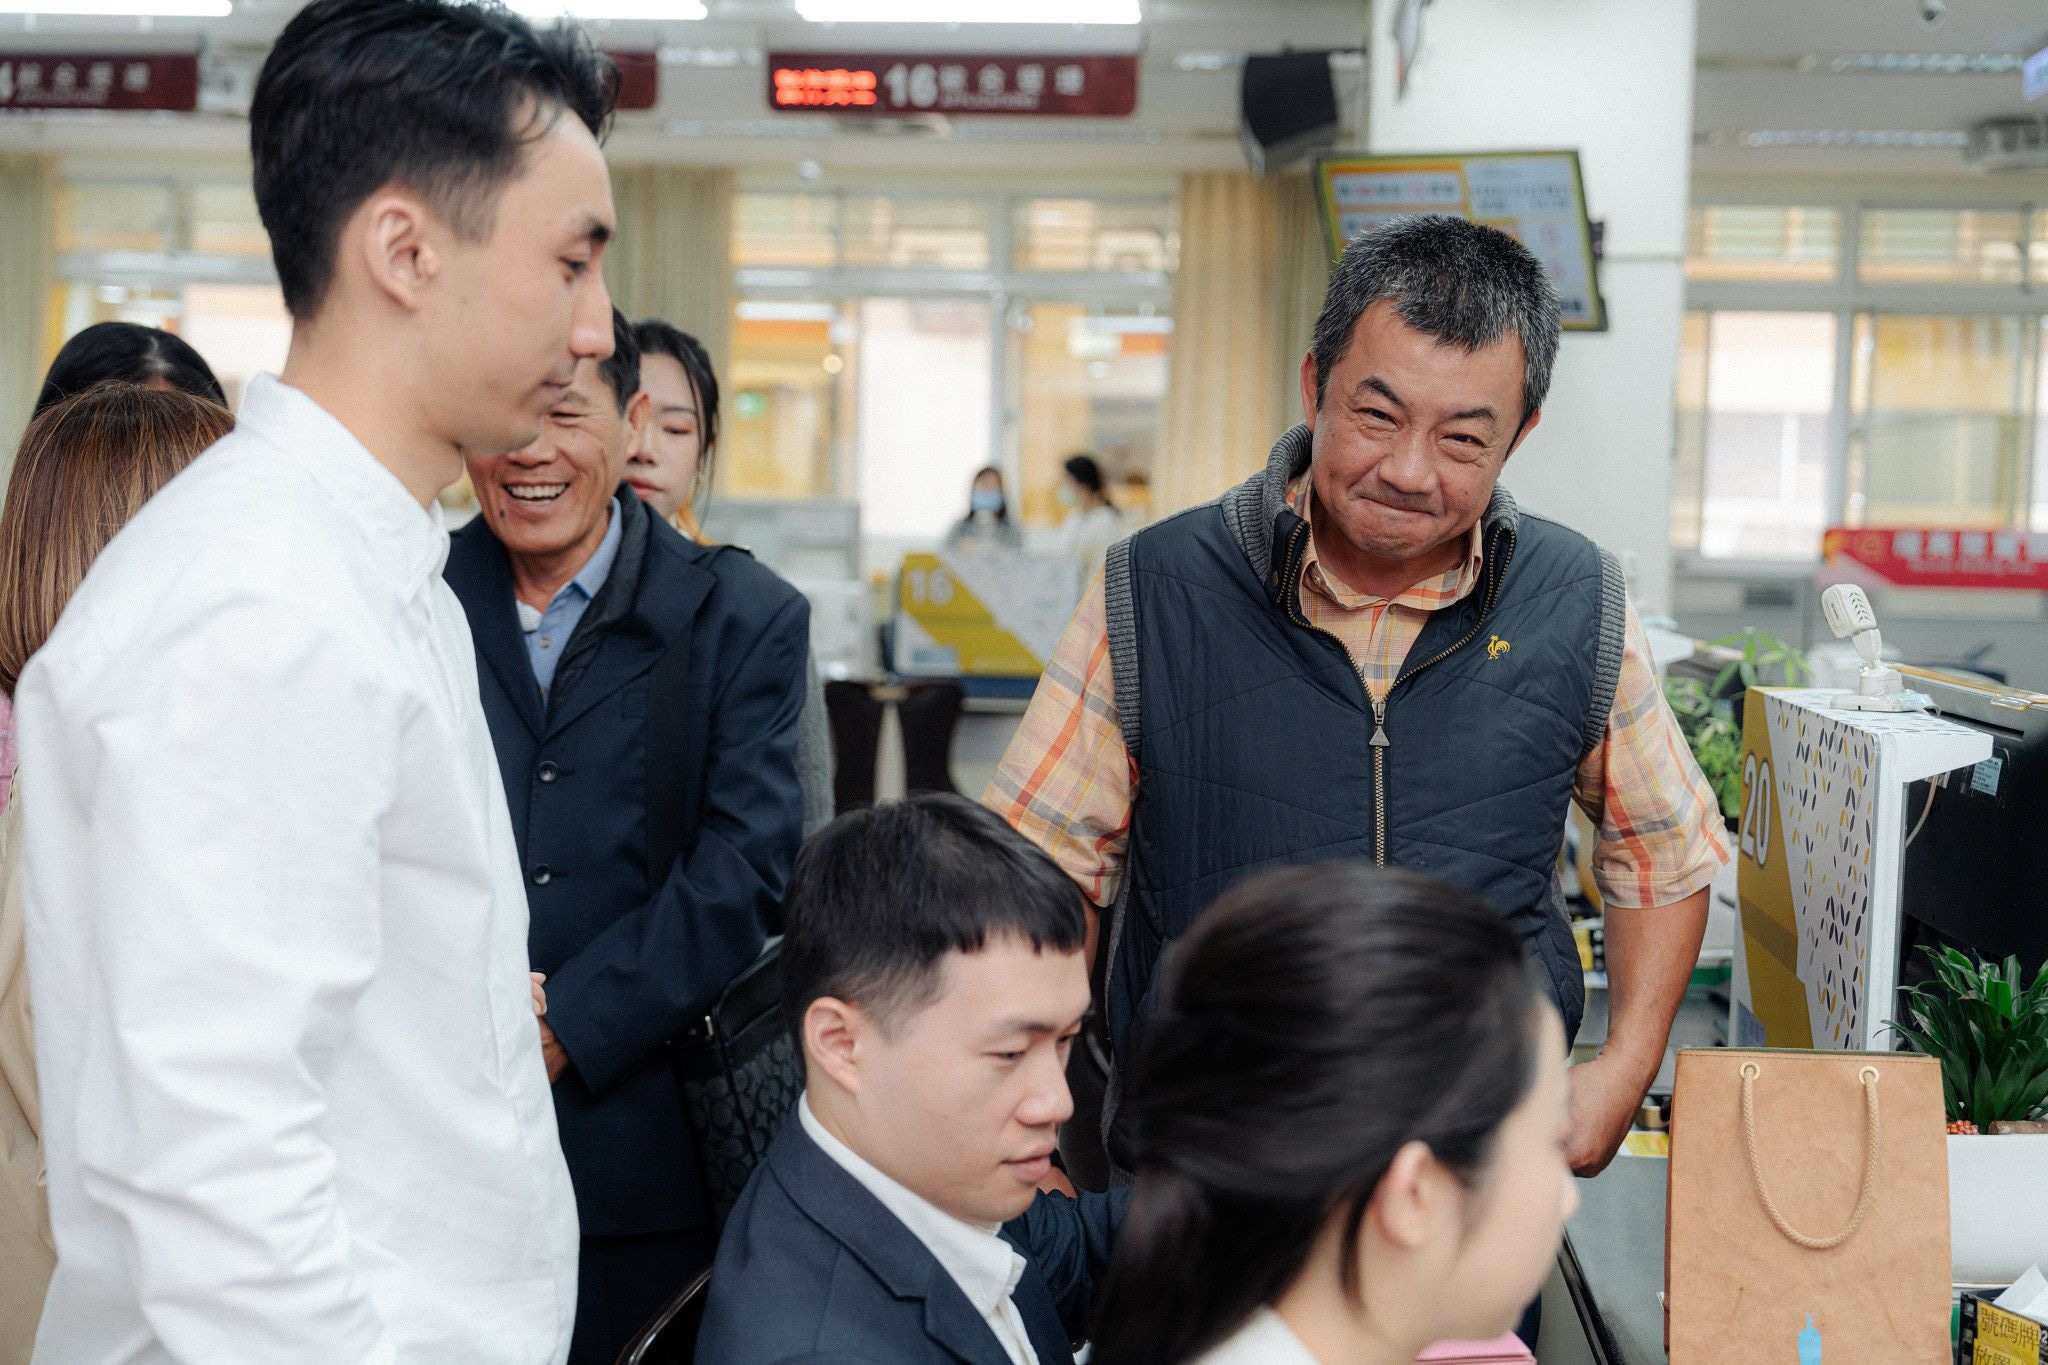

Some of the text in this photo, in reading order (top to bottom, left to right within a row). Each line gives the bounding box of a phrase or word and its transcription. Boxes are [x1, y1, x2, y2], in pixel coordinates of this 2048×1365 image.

[1741, 752, 1770, 867] 20
[1981, 1307, 2039, 1351] 號碼牌
